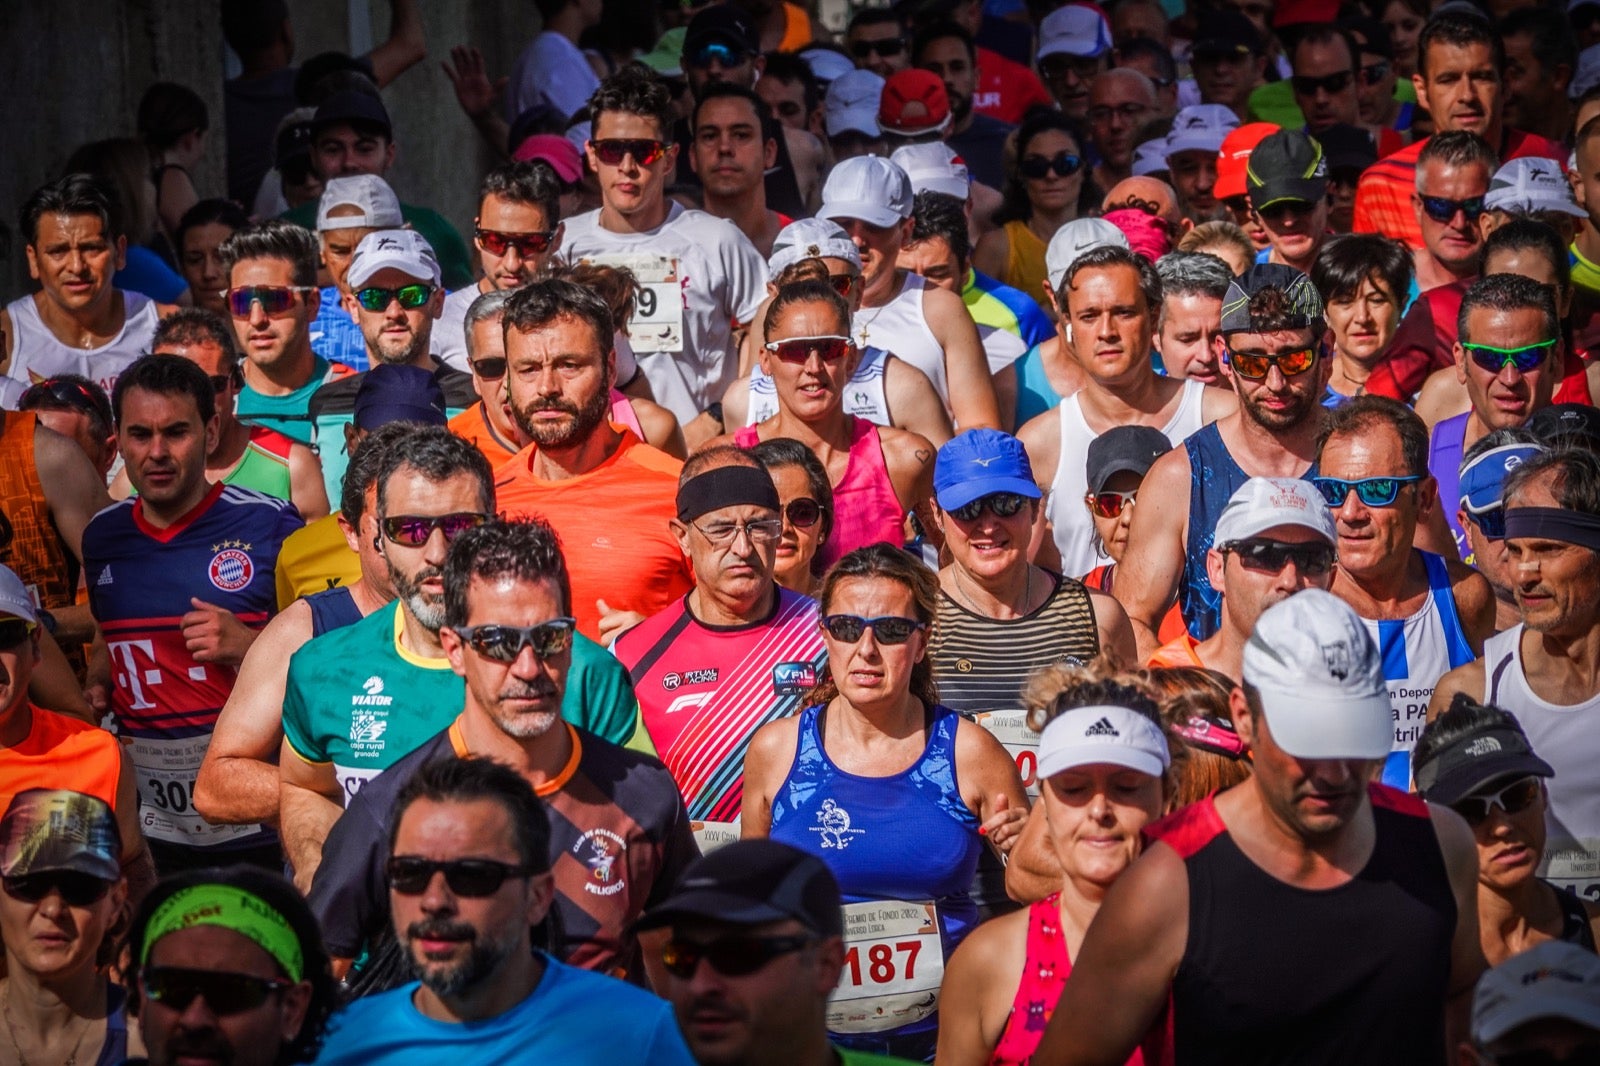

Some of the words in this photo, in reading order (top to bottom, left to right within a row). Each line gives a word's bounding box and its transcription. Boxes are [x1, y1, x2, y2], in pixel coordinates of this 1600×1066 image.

[638, 287, 657, 317] 9
[221, 551, 248, 566] BAYERN
[680, 669, 715, 680] VIRTUAL
[683, 675, 718, 686] RACING
[352, 695, 393, 706] VIATOR
[993, 717, 1008, 728] XXXV
[350, 742, 365, 750] caja
[366, 740, 385, 750] rural
[354, 750, 379, 758] granada
[573, 835, 586, 853] CLUB
[584, 829, 594, 839] DE
[584, 879, 625, 896] PELIGROS
[868, 912, 877, 922] DE
[878, 909, 899, 920] FONDO
[900, 908, 919, 919] 2022
[843, 940, 922, 986] 187
